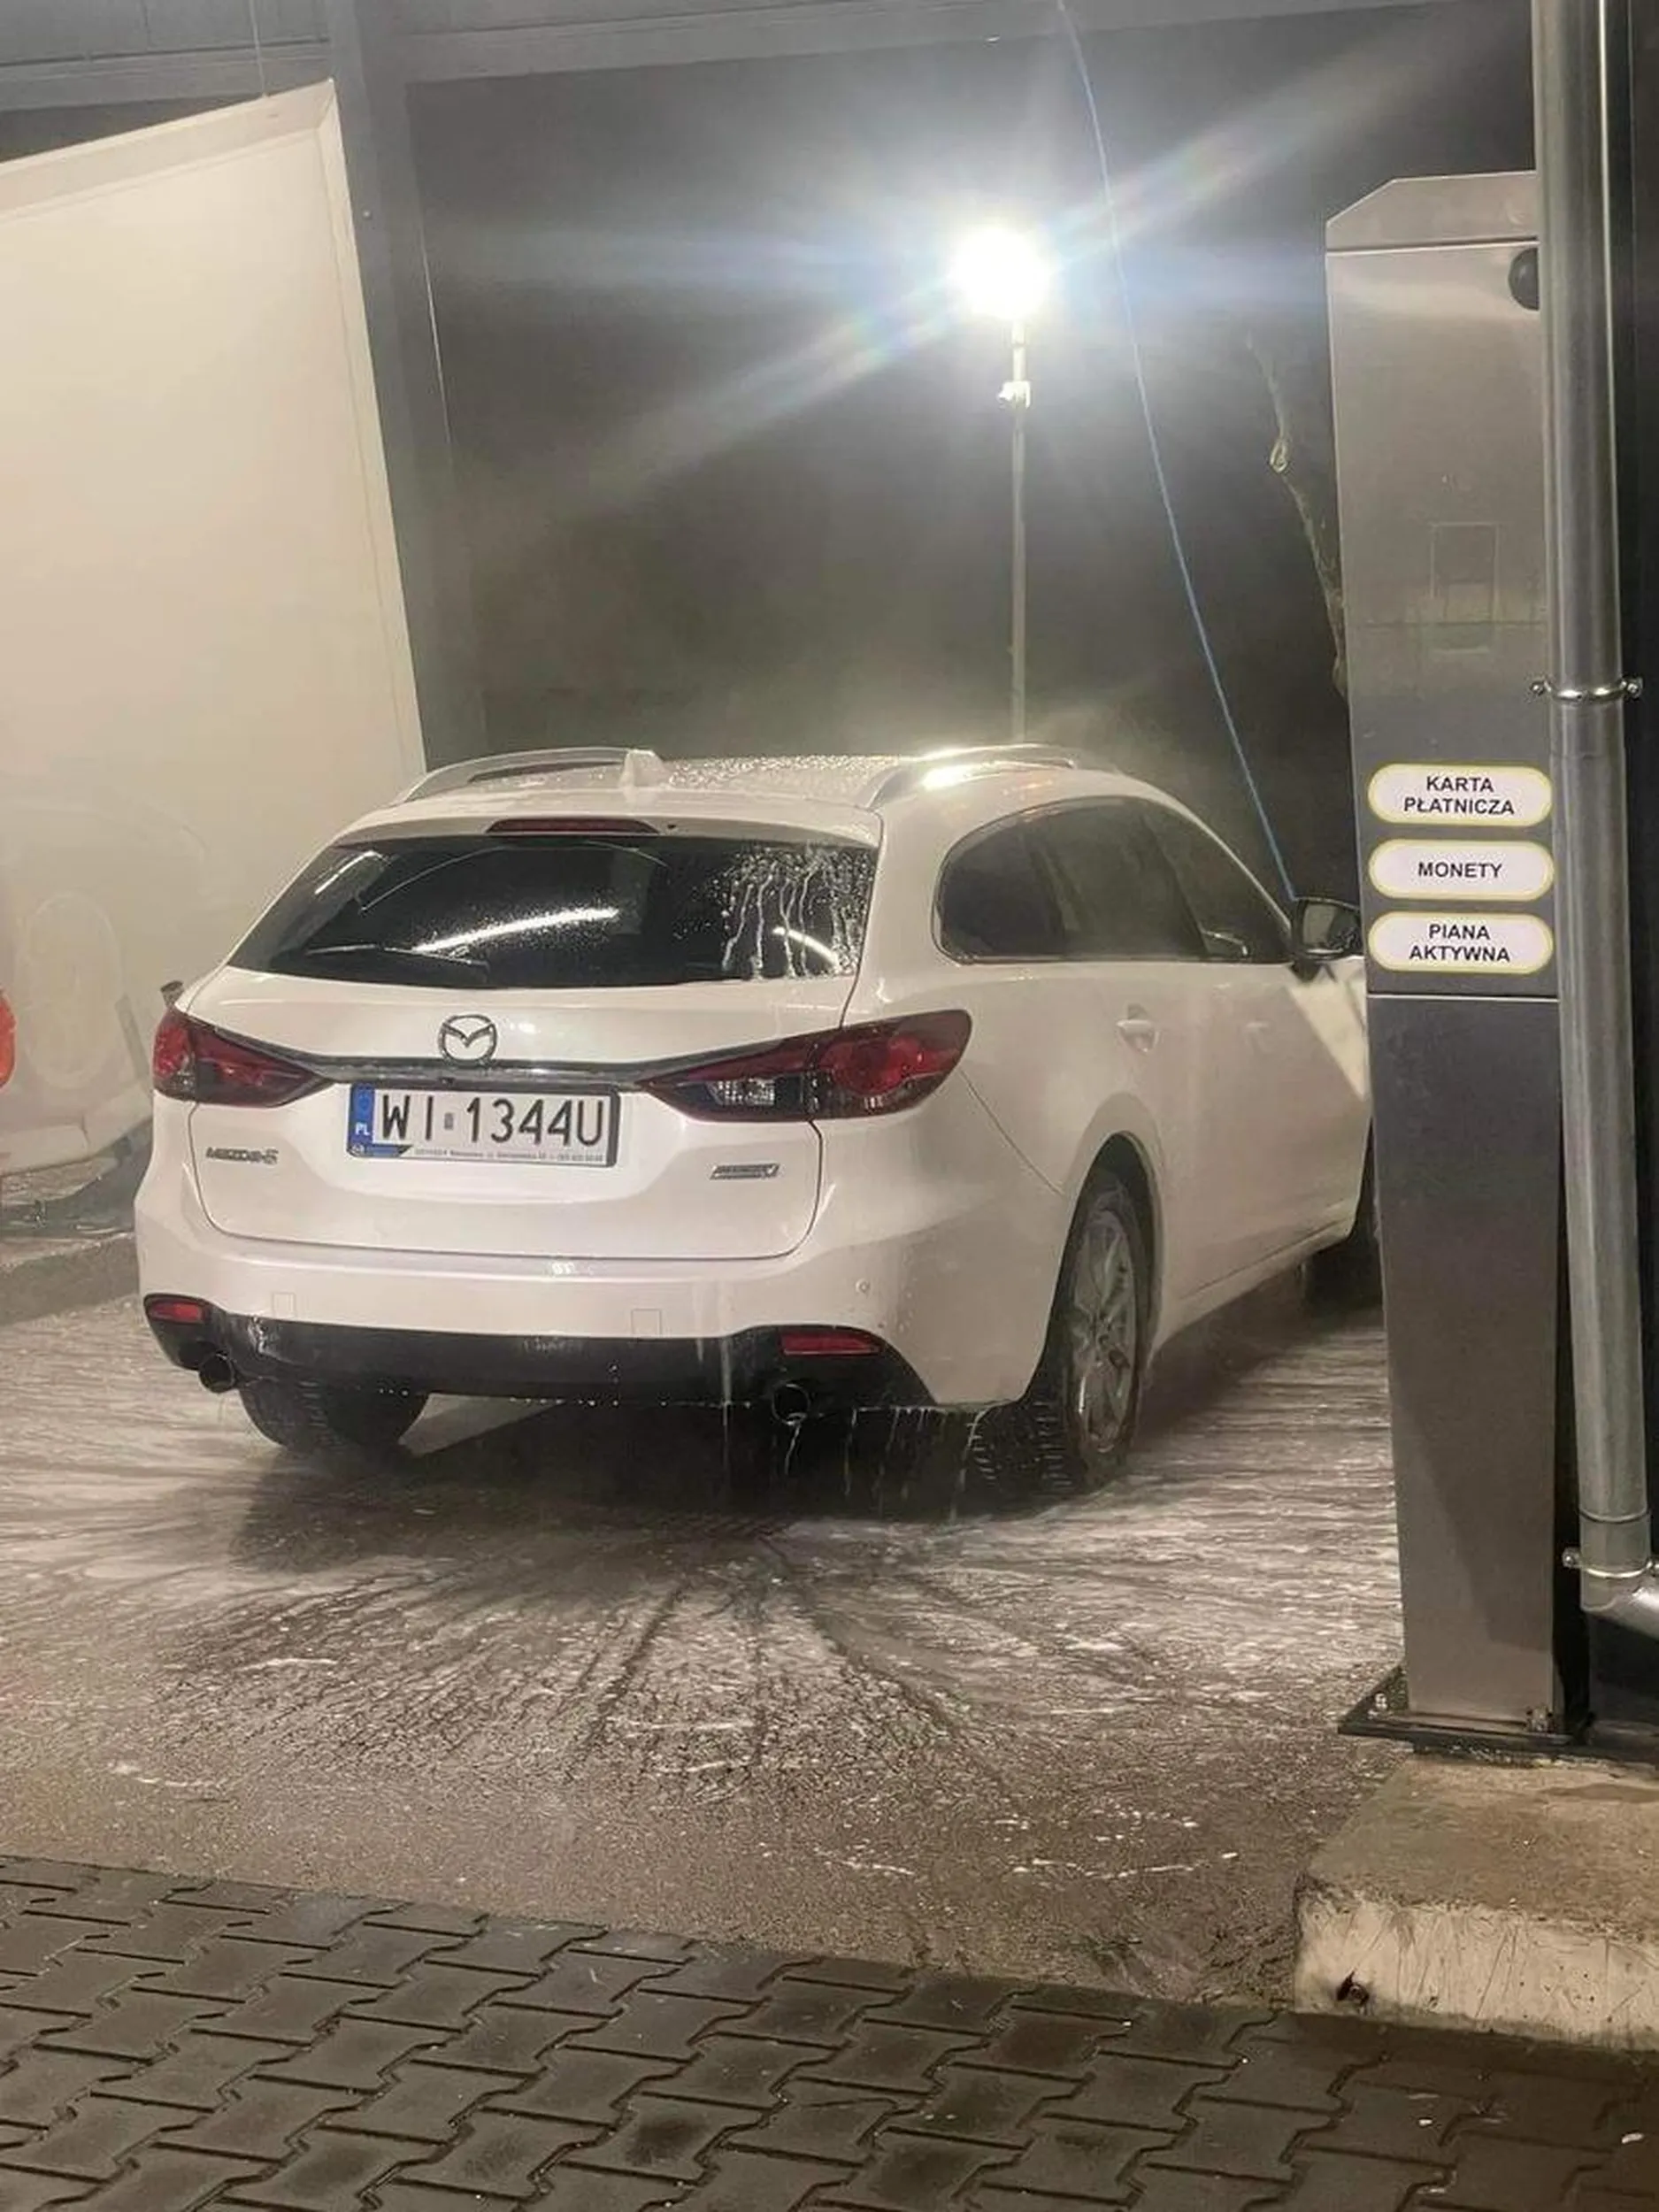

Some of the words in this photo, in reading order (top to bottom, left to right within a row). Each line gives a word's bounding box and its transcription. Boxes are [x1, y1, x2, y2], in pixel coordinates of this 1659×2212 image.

[1426, 776, 1494, 793] KARTA
[1403, 796, 1515, 815] PŁATNICZA
[1417, 862, 1502, 879] MONETY
[1428, 924, 1490, 941] PIANA
[1409, 945, 1510, 963] AKTYWNA
[355, 1122, 371, 1136] PL
[382, 1094, 434, 1141] WI
[466, 1096, 603, 1147] 1344U
